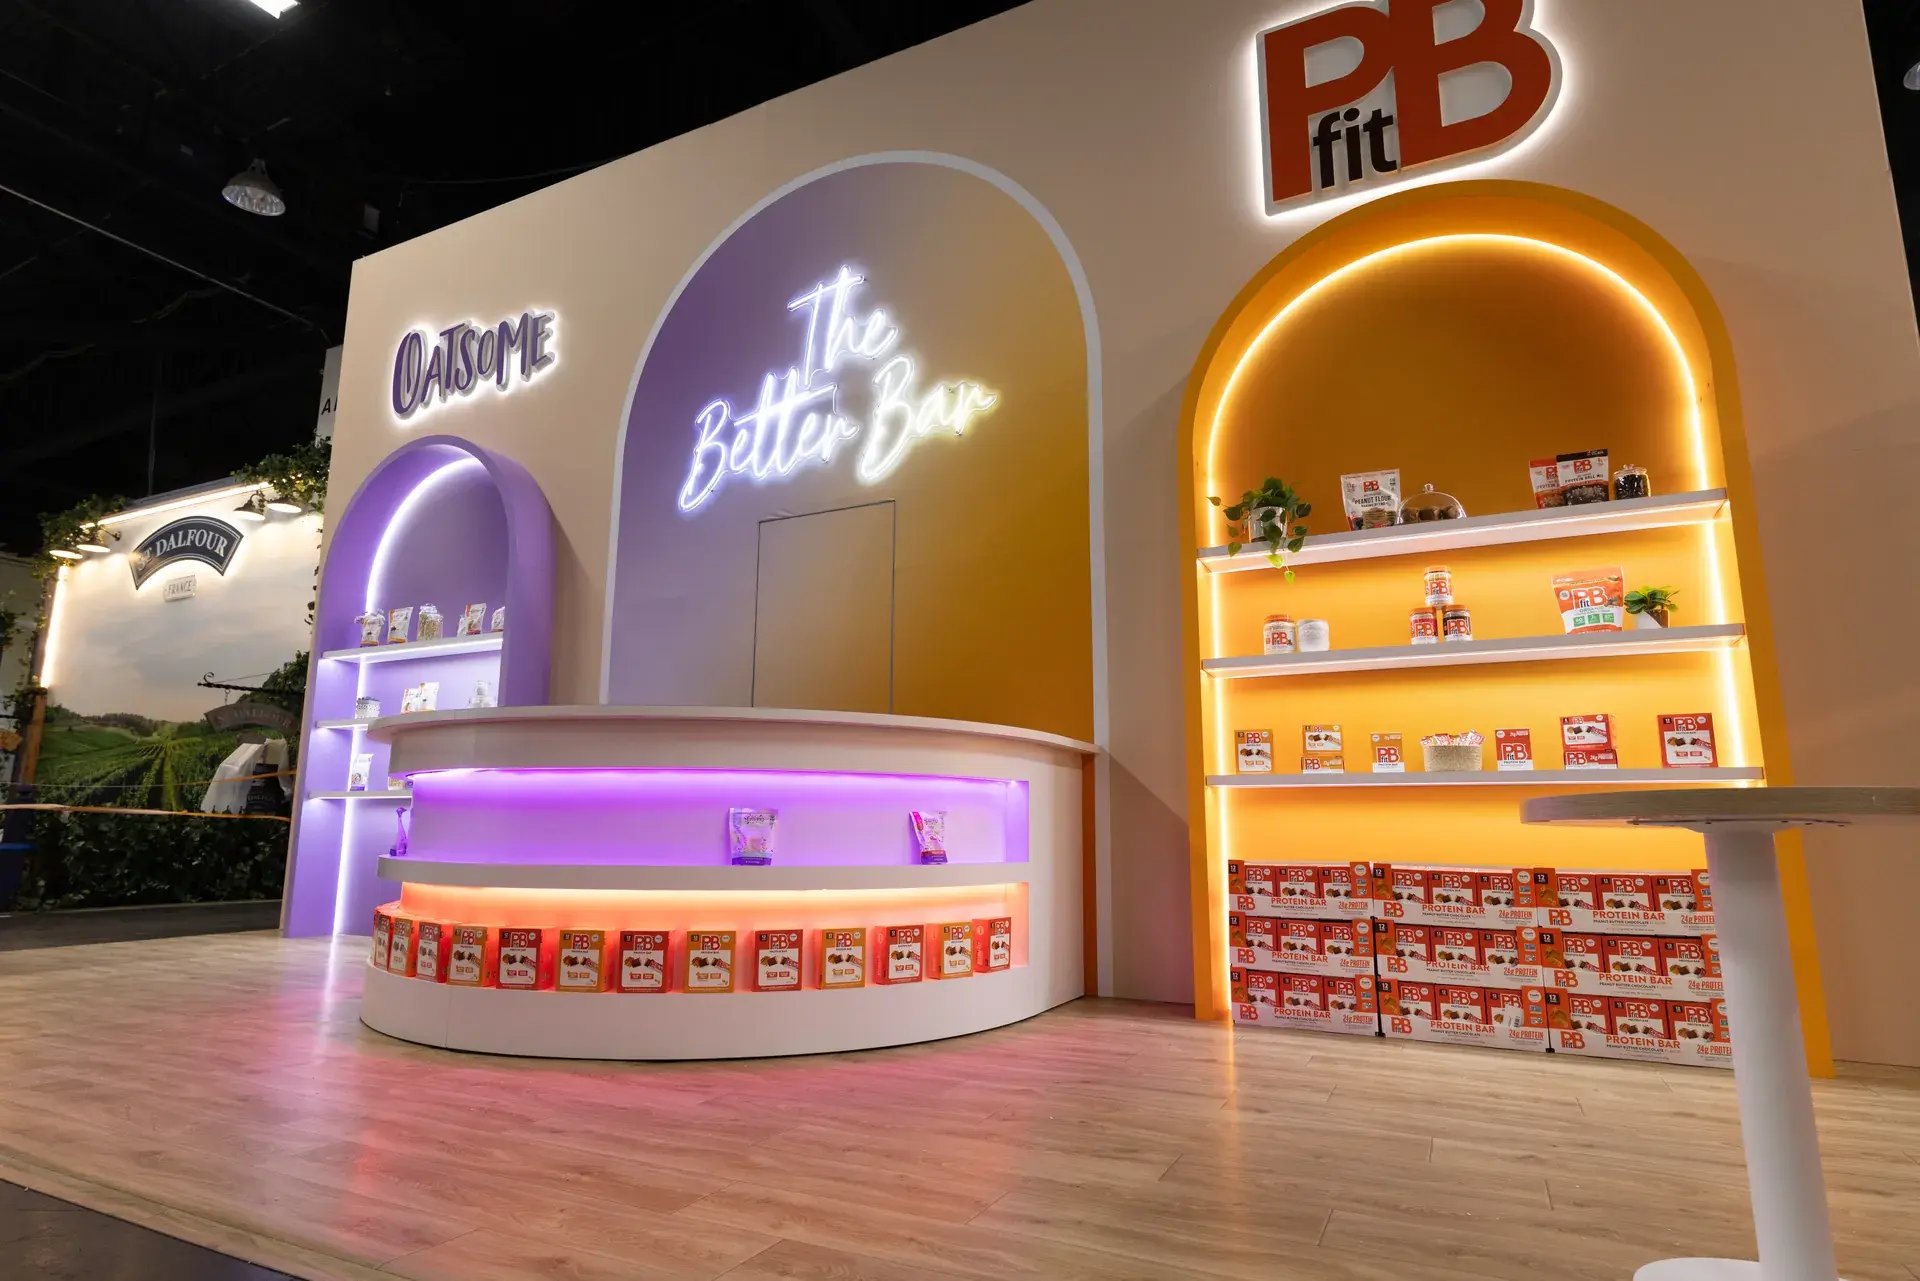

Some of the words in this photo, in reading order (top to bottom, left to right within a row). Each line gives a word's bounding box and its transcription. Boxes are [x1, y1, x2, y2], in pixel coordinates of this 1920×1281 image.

[1264, 0, 1551, 202] PB
[1313, 107, 1397, 189] fit
[788, 265, 899, 386] The
[393, 312, 555, 419] OATSOME
[679, 367, 860, 510] Better
[858, 355, 998, 483] Bar
[155, 528, 228, 557] DALFOUR
[167, 580, 193, 596] FRANCE
[1573, 588, 1607, 609] PB
[1580, 599, 1590, 608] fit
[1377, 747, 1399, 762] PB
[1503, 745, 1527, 760] PB
[1567, 753, 1586, 765] PB
[1237, 896, 1255, 910] PB
[1384, 902, 1404, 918] PB
[1423, 904, 1463, 913] PROTEIN
[1511, 911, 1532, 919] PROTEIN
[1549, 909, 1572, 926] PB
[1593, 911, 1640, 919] PROTEIN
[1681, 915, 1693, 924] 24g
[1694, 916, 1715, 924] PROTEI
[1238, 949, 1256, 964] PB
[1272, 951, 1309, 960] PROTEIN
[1311, 954, 1328, 963] BAR
[1350, 959, 1370, 968] PROTEIN
[1387, 957, 1408, 973] PB
[1426, 961, 1468, 970] PROTEIN
[1471, 964, 1489, 972] BAR
[1515, 968, 1538, 976] PROTEIN
[1554, 970, 1578, 987] PB
[1599, 974, 1647, 984] PROTEIN
[1651, 977, 1672, 985] BAR
[1689, 980, 1700, 989] 24g
[1702, 981, 1723, 990] PROTEI
[1240, 1005, 1258, 1020] PB
[1274, 1008, 1311, 1017] PROTEIN
[1314, 1010, 1331, 1019] BAR
[1354, 1015, 1373, 1024] PROTEIN
[1391, 1017, 1412, 1034] PB
[1431, 1021, 1473, 1031] PROTEIN
[1476, 1024, 1495, 1033] BAR
[1520, 1030, 1543, 1039] PROTEIN
[1560, 1032, 1585, 1049] PB
[1606, 1036, 1655, 1046] PROTEIN
[1659, 1039, 1680, 1049] BAR
[1697, 1045, 1709, 1054] 24g
[1710, 1046, 1731, 1055] PROTEI
